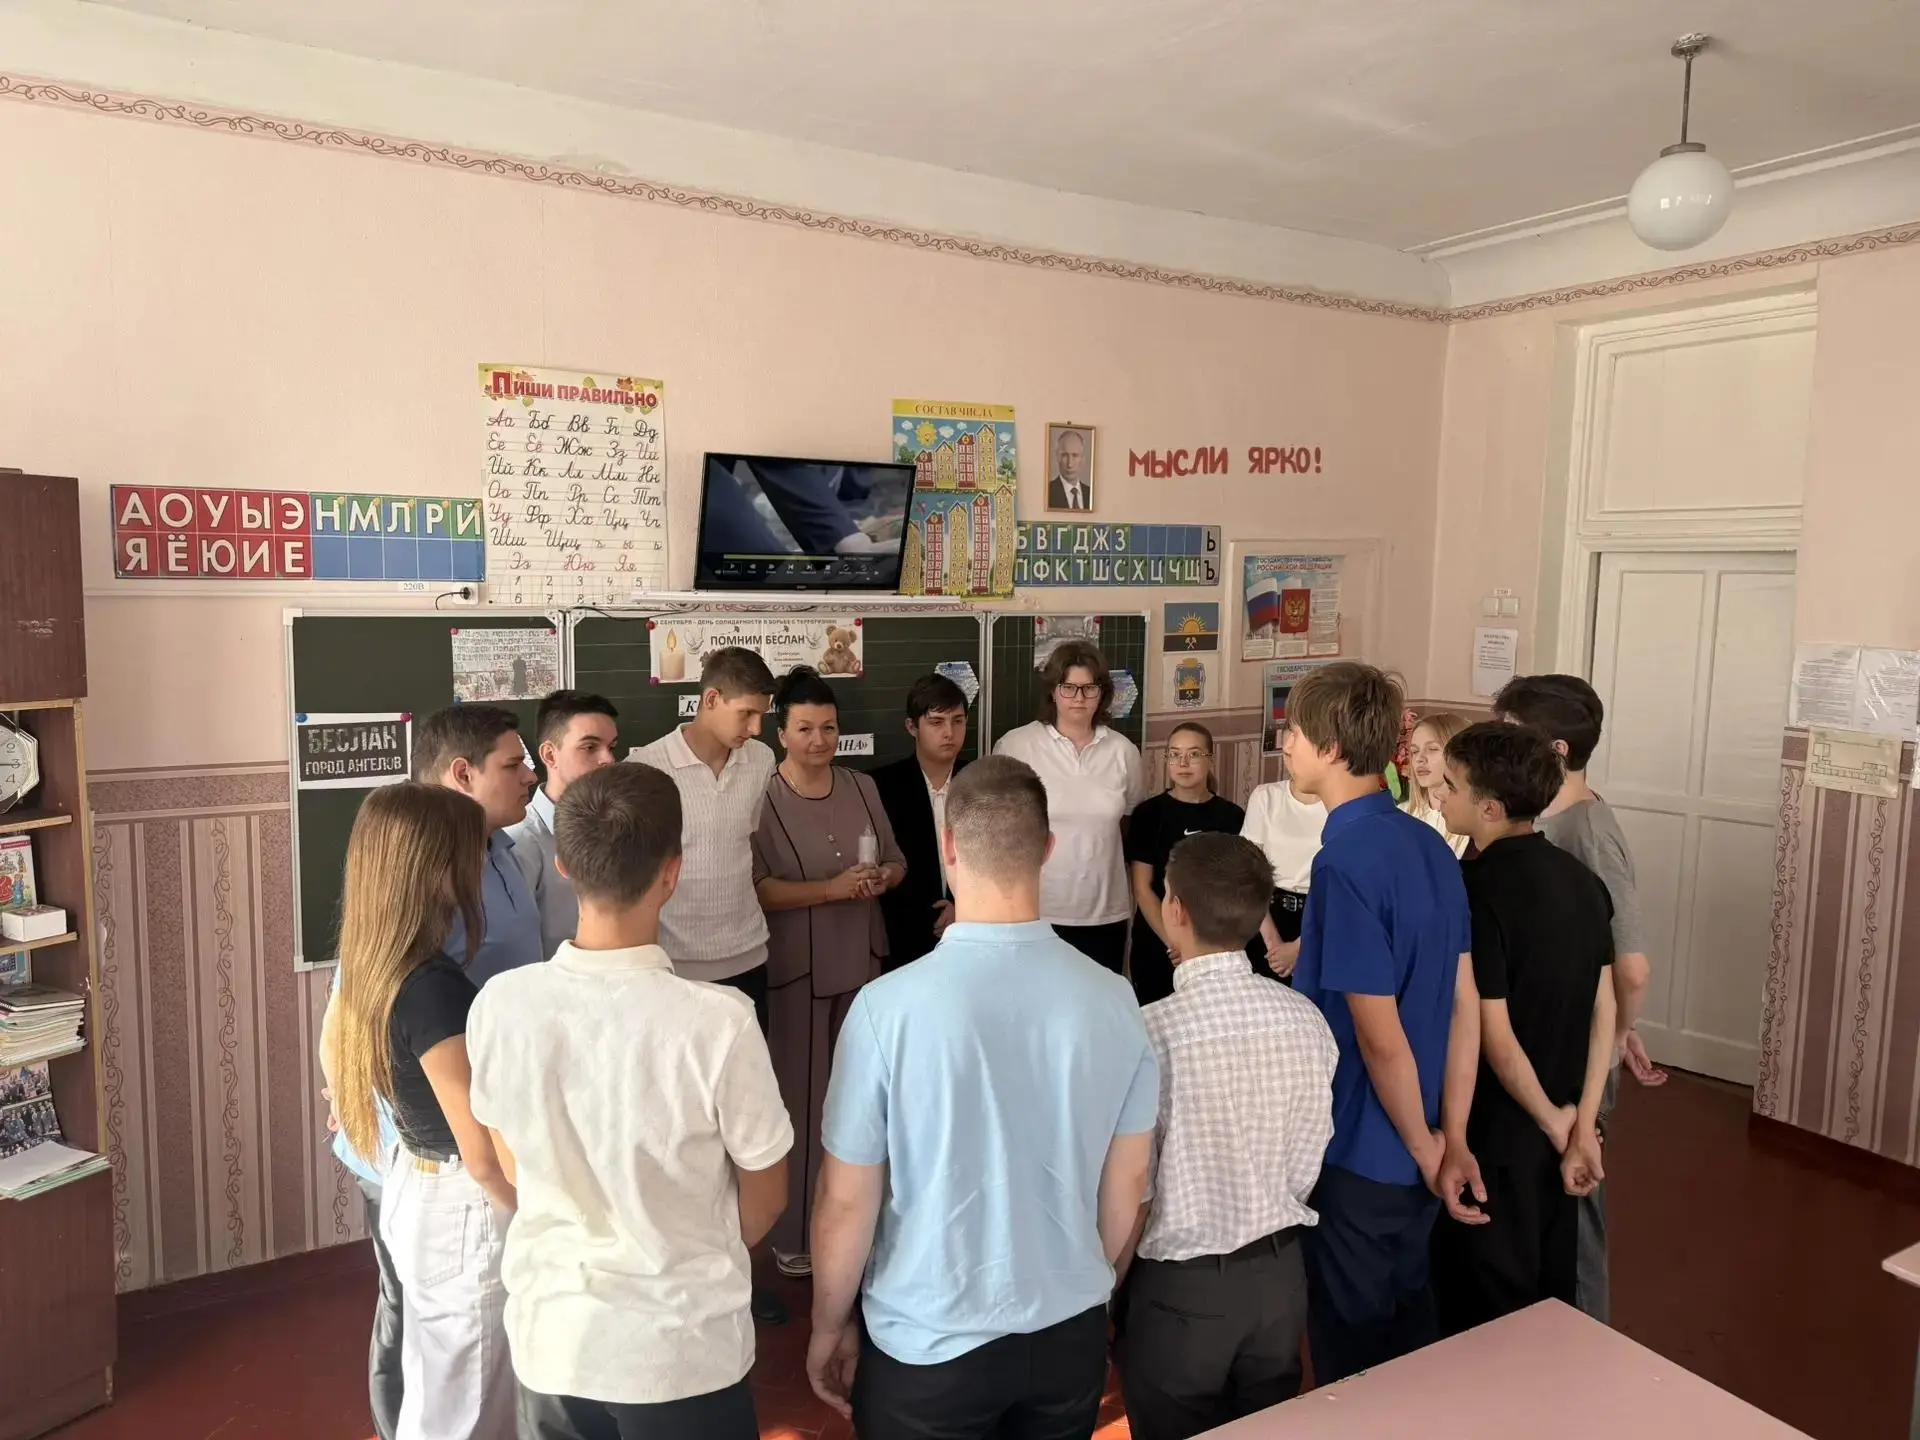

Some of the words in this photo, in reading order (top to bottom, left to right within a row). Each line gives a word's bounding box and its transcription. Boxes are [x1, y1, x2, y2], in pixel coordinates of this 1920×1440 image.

[915, 404, 957, 416] СОСТАВ
[959, 408, 993, 417] ЧИСЛА
[1128, 446, 1229, 478] МЫСЛИ
[1247, 446, 1322, 474] ЯРКО!
[710, 635, 762, 646] ПОМНИМ
[765, 635, 805, 645] БЕСЛАН
[307, 725, 397, 754] БЕСЛАН
[305, 759, 346, 775] ГОРОД
[347, 756, 402, 772] АНГЕЛОВ
